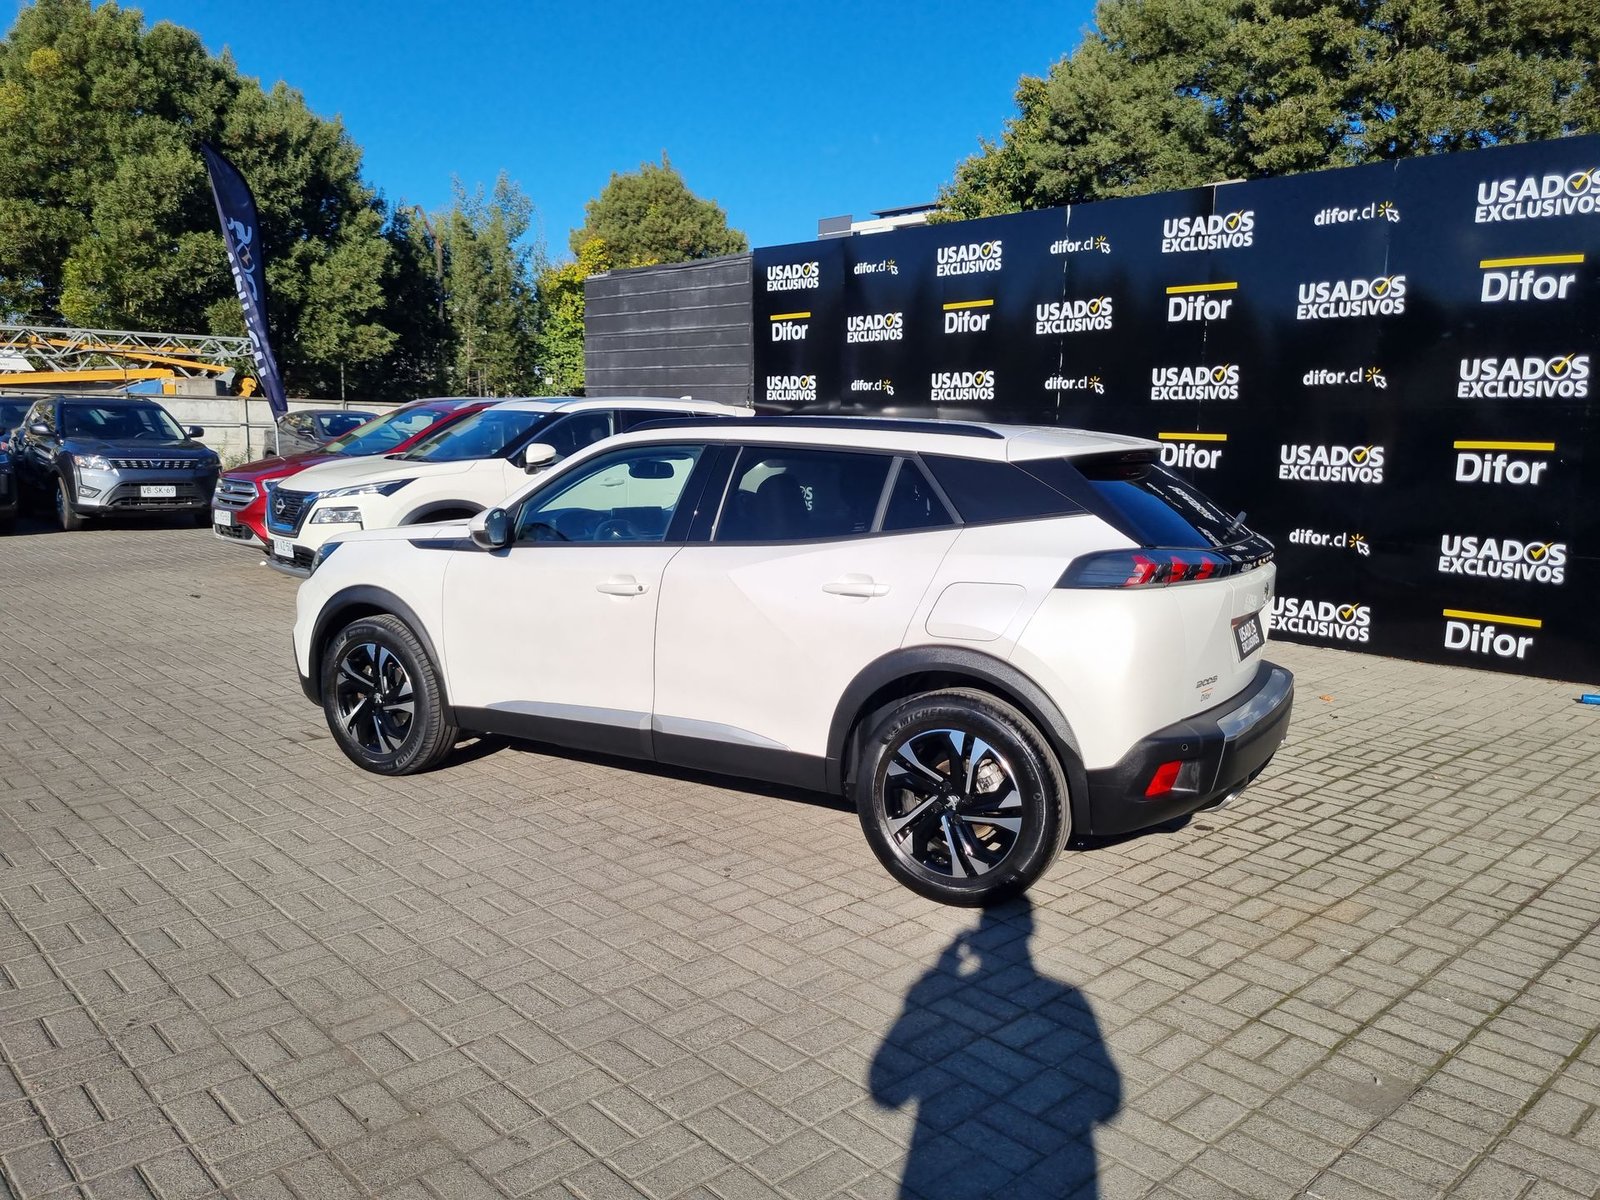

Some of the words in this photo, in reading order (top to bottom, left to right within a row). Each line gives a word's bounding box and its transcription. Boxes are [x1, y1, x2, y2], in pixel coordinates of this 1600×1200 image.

[1163, 211, 1254, 238] USADOS
[1314, 203, 1375, 226] difor.cl
[937, 241, 1002, 264] USADOS
[1050, 236, 1093, 254] difor.cl
[1161, 232, 1253, 253] EXCLUSIVOS
[767, 262, 819, 280] USADOS
[854, 260, 886, 275] difor.cl
[936, 257, 1001, 276] EXCLUSIVOS
[767, 277, 819, 291] EXCLUSIVOS
[1298, 276, 1406, 303] USADOS
[1480, 270, 1576, 302] Difor
[1036, 297, 1112, 321] USADOS
[1167, 295, 1232, 323] Difor
[1297, 298, 1405, 320] EXCLUSIVOS
[772, 322, 808, 341] Difor
[847, 312, 903, 332] USADOS
[944, 310, 990, 333] Difor
[1035, 315, 1112, 334] EXCLUSIVOS
[847, 328, 903, 343] EXCLUSIVOS
[1152, 365, 1239, 386] USADOS
[1303, 367, 1363, 386] difor.cl
[1459, 355, 1590, 382] USADOS
[767, 375, 816, 390] USADOS
[851, 380, 882, 392] difor.cl
[931, 370, 994, 388] USADOS
[1045, 376, 1087, 390] difor.cl
[1457, 379, 1588, 398] EXCLUSIVOS
[766, 388, 816, 400] EXCLUSIVOS
[930, 386, 994, 401] EXCLUSIVOS
[1151, 382, 1239, 400] EXCLUSIVOS
[1160, 443, 1222, 469] Difor
[1280, 444, 1384, 468] USADOS
[1279, 465, 1383, 483] EXCLUSIVOS
[1455, 453, 1547, 484] Difor
[1289, 528, 1347, 547] difor.cl
[1441, 535, 1567, 566] USADOS
[1438, 556, 1565, 584] EXCLUSIVOS
[1271, 597, 1371, 627] USADOS
[1269, 618, 1369, 642] EXCLUSIVOS
[1444, 620, 1533, 659] Difor
